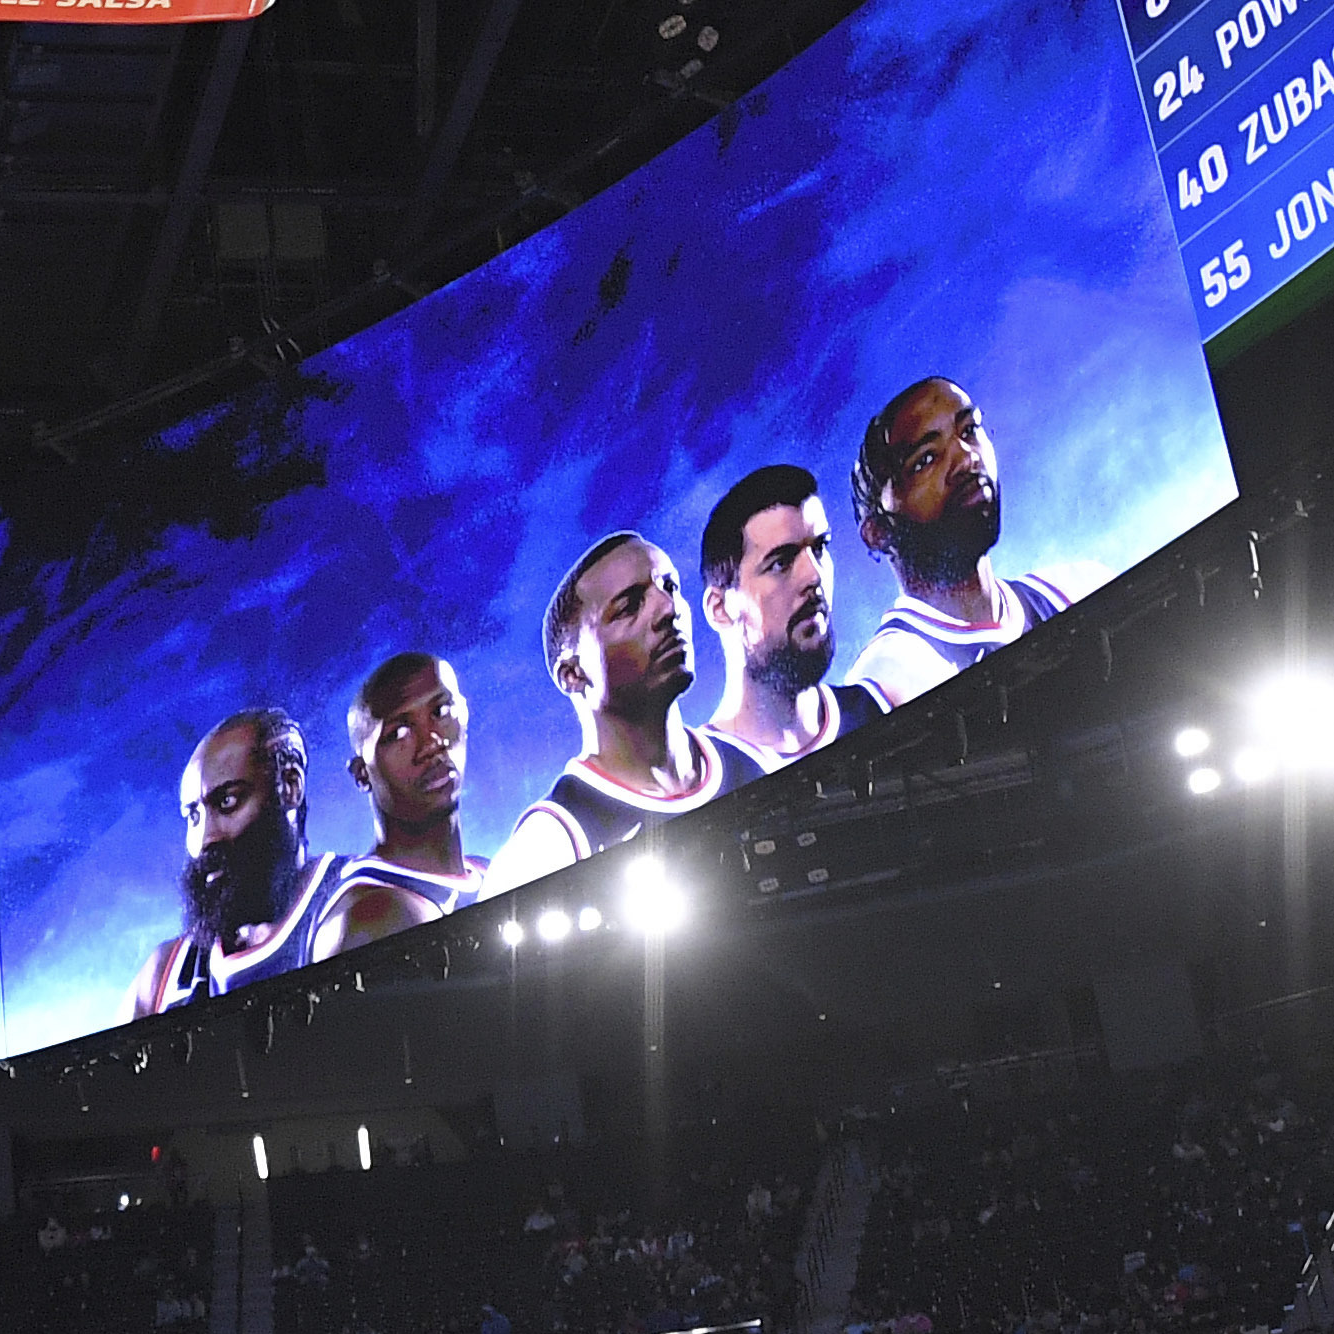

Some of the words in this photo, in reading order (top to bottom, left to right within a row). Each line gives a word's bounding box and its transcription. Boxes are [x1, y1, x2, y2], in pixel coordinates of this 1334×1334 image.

[1153, 55, 1205, 121] 24
[1215, 0, 1309, 69] POW
[1177, 144, 1228, 210] 40
[1238, 46, 1334, 165] ZUBA
[1200, 238, 1251, 308] 55
